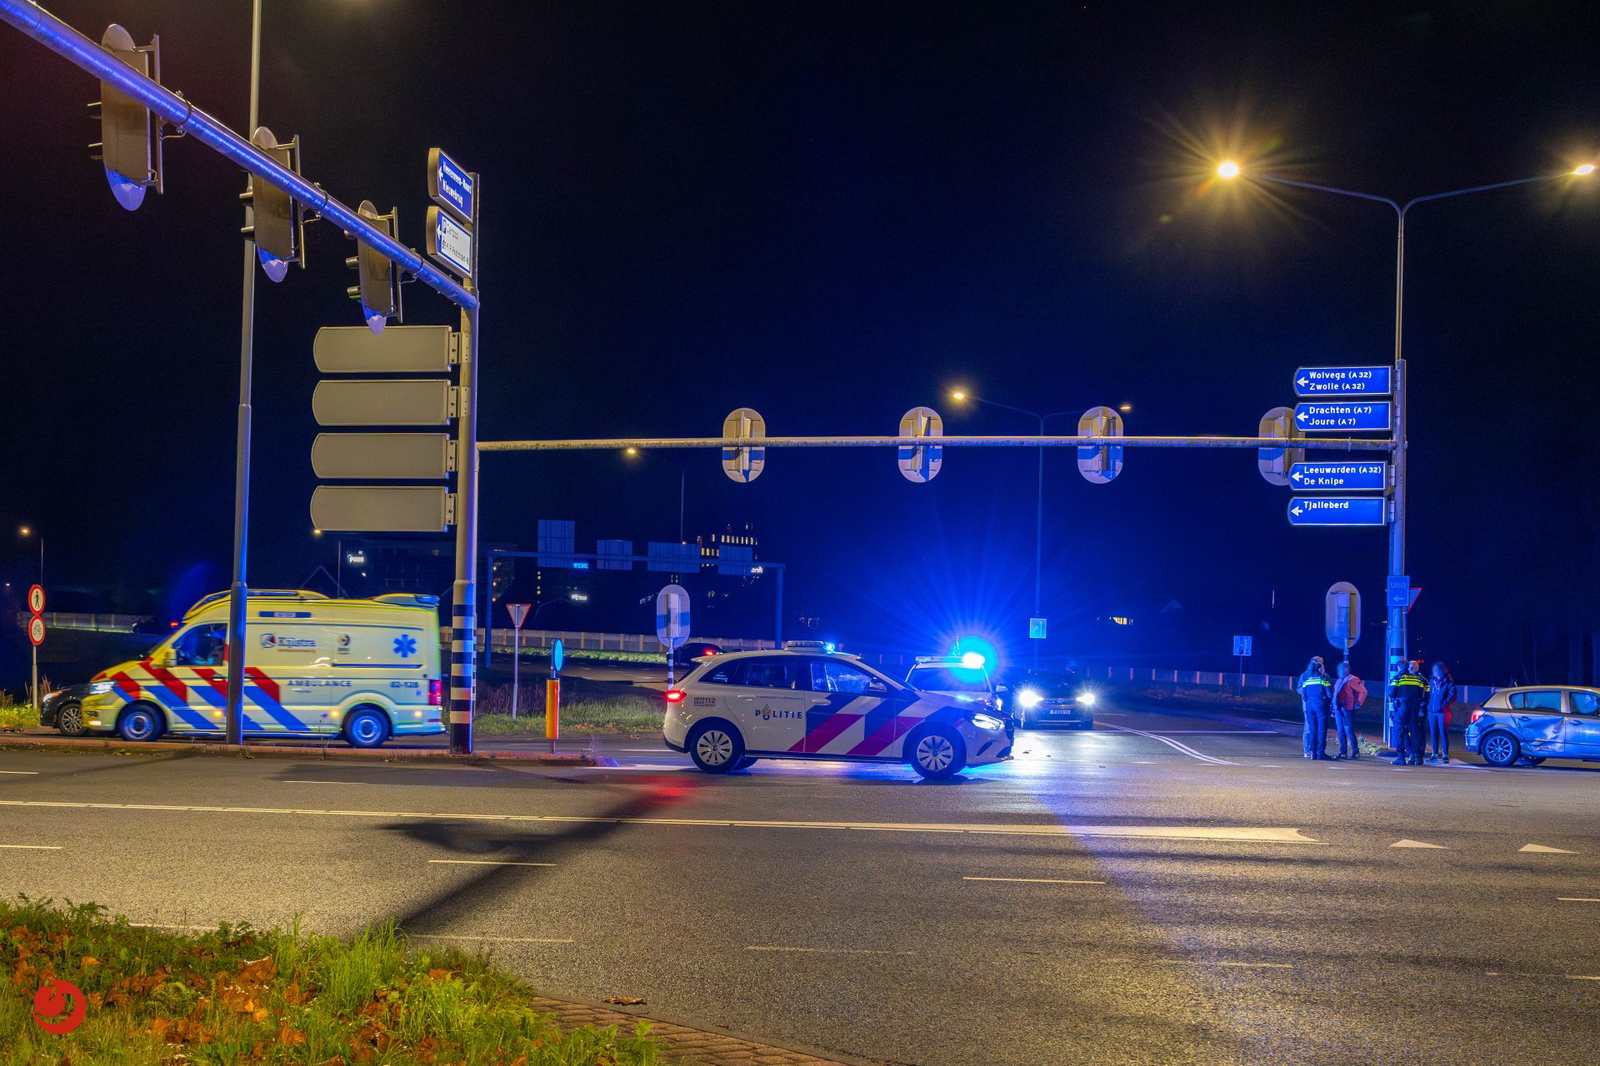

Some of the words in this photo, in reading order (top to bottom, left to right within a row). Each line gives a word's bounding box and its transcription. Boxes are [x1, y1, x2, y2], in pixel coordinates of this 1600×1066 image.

[1309, 371, 1346, 380] Wolvega
[1318, 478, 1344, 486] Knipe
[1304, 501, 1349, 510] Tjalleberd
[755, 709, 802, 720] POLITIE
